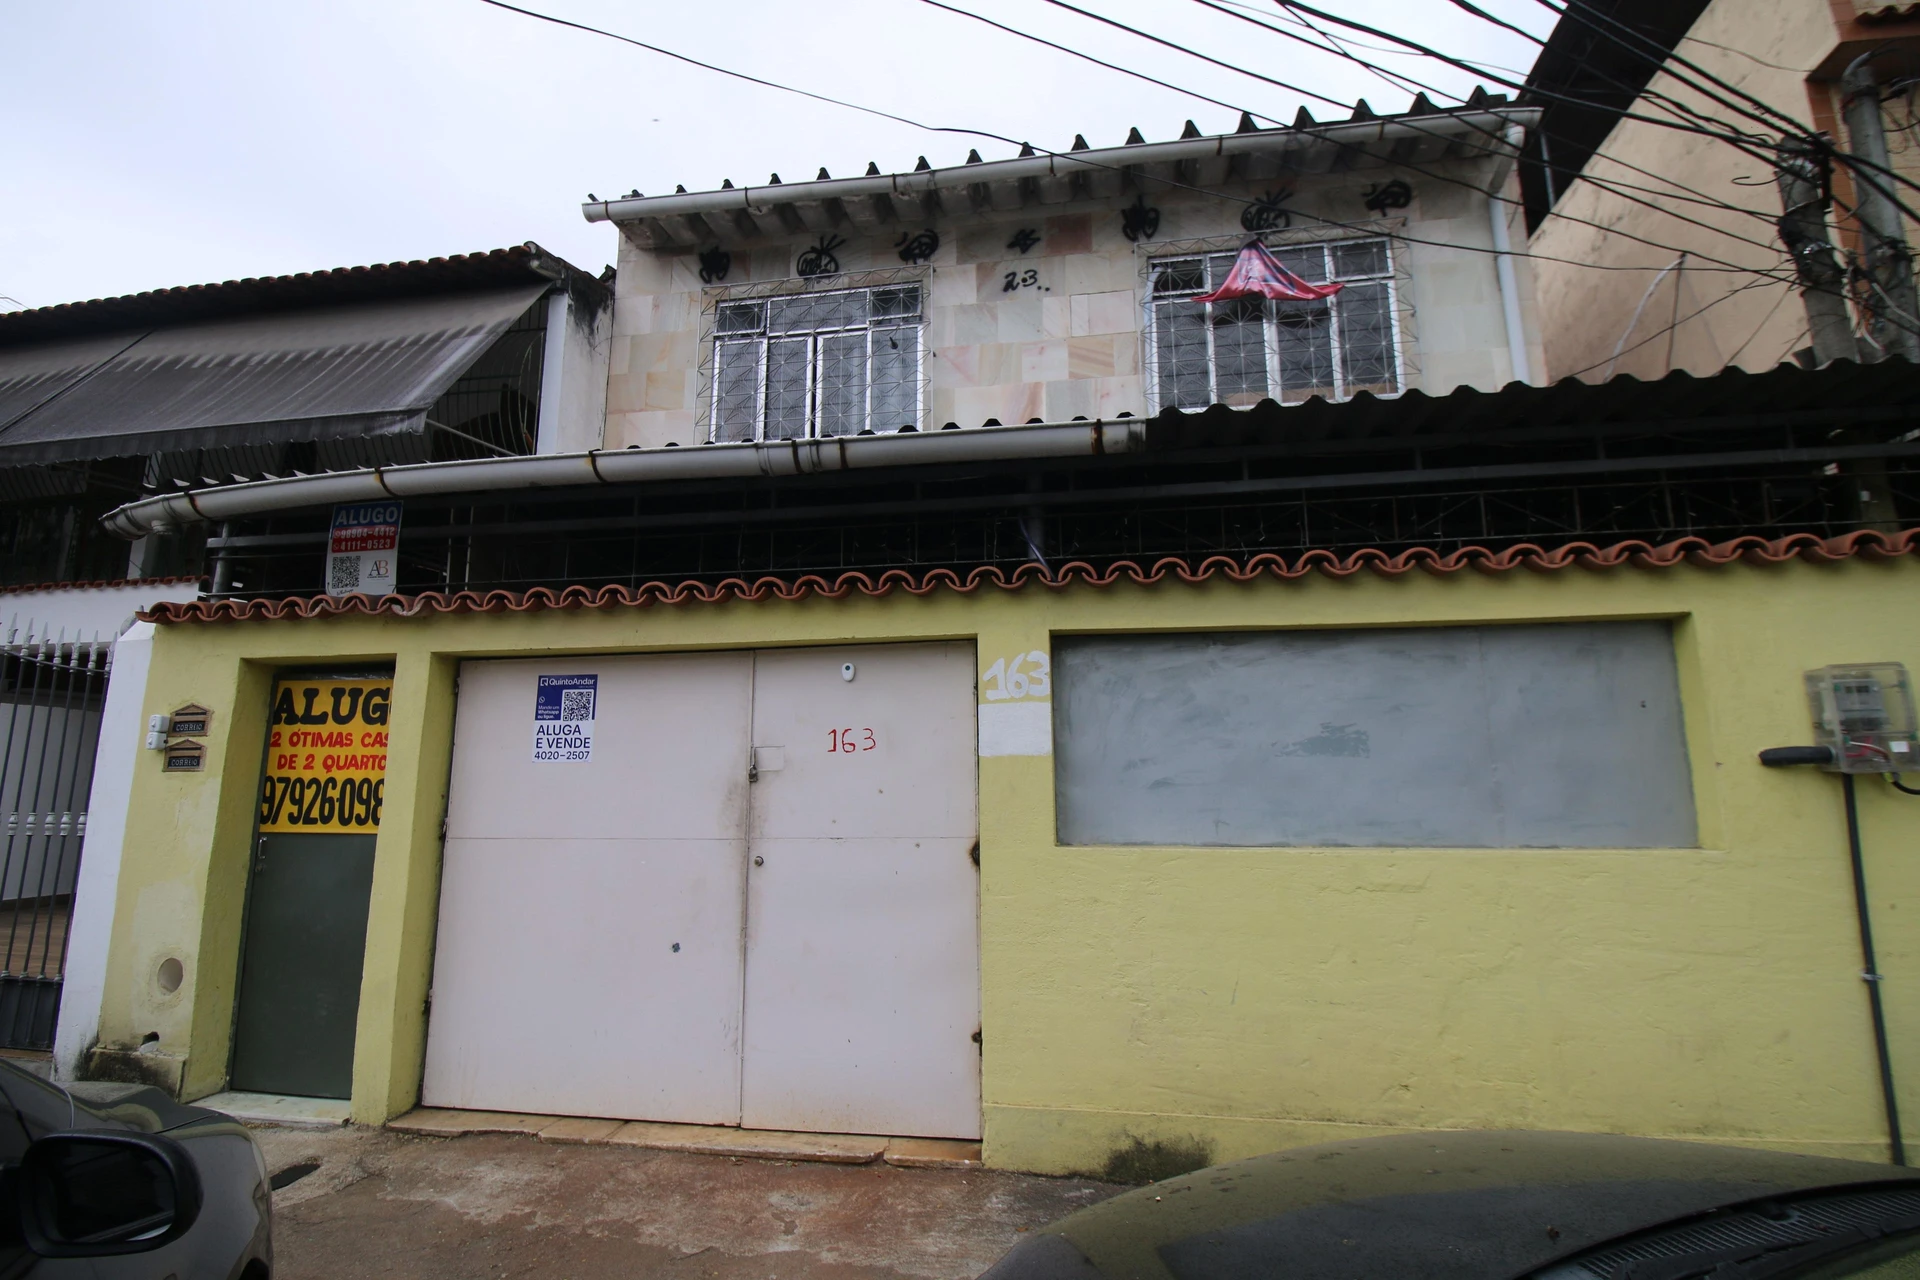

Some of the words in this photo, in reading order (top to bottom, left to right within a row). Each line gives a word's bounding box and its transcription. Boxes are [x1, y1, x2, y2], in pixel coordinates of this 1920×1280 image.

[336, 506, 398, 526] ALUGO
[340, 538, 391, 551] 4111-0523
[549, 677, 595, 686] QuintoAndar
[982, 650, 1050, 701] 163
[272, 687, 392, 726] ALUG
[536, 724, 581, 736] ALUGA
[270, 731, 282, 748] 2
[288, 728, 354, 748] ÓTIMAS
[536, 737, 543, 749] E
[547, 737, 591, 749] VENDE
[827, 727, 877, 753] 163
[171, 759, 198, 767] CORREIO
[276, 754, 298, 771] DE
[302, 753, 315, 770] 2
[534, 751, 590, 760] 4020-2507
